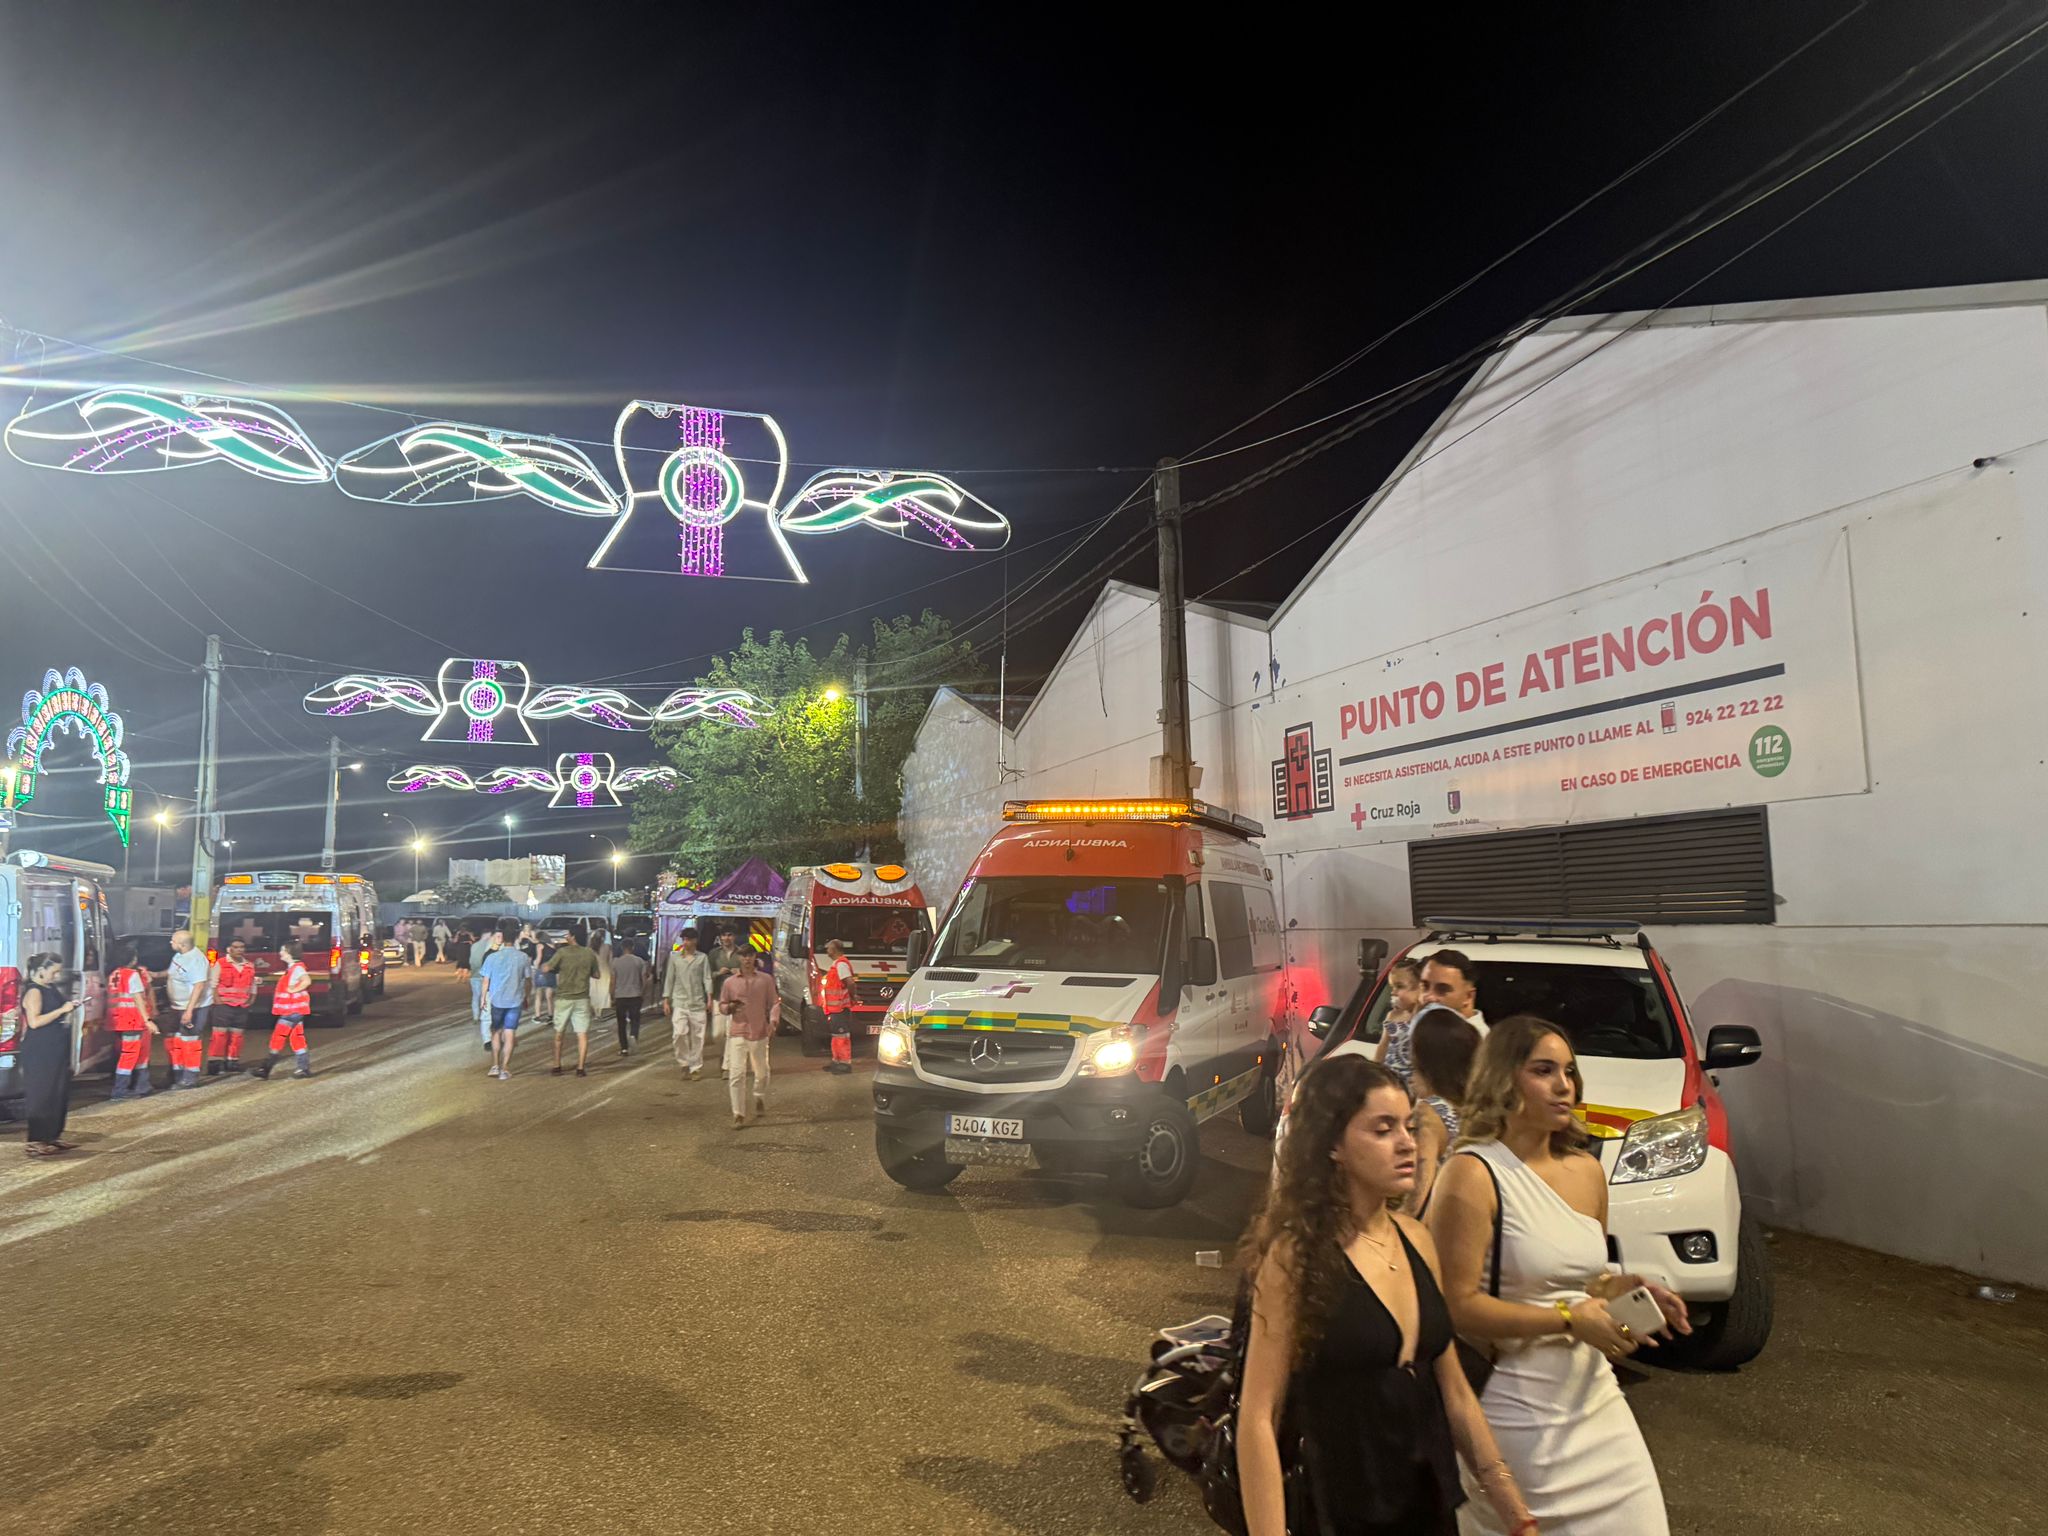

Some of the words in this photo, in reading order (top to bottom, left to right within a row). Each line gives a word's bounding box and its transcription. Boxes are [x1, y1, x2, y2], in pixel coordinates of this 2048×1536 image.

[1340, 681, 1445, 740] PUNTO
[1456, 662, 1507, 712] DE
[1518, 588, 1772, 698] ATENCIÓN
[1344, 777, 1352, 787] SI
[1353, 769, 1394, 786] NECESITA
[1395, 759, 1453, 778] ASISTENCIA,
[1454, 752, 1490, 768] ACUDA
[1492, 749, 1501, 761] A
[1503, 743, 1531, 758] ESTE
[1534, 735, 1575, 754] PUNTO
[1589, 724, 1633, 744] LLAME
[1636, 720, 1654, 735] AL
[1686, 709, 1713, 726] 924
[1717, 704, 1735, 721] 22
[1740, 700, 1759, 716] 22
[1764, 695, 1784, 711] 22
[1755, 734, 1784, 756] 112
[1561, 778, 1578, 792] EN
[1581, 772, 1617, 789] CASO
[1620, 769, 1639, 784] DE
[1643, 753, 1741, 781] EMERGENCIA
[1370, 807, 1394, 820] Cruz
[1397, 801, 1420, 818] Roja
[728, 893, 762, 901] PUNTO
[954, 1118, 987, 1134] 3404
[992, 1120, 1019, 1136] KGZ
